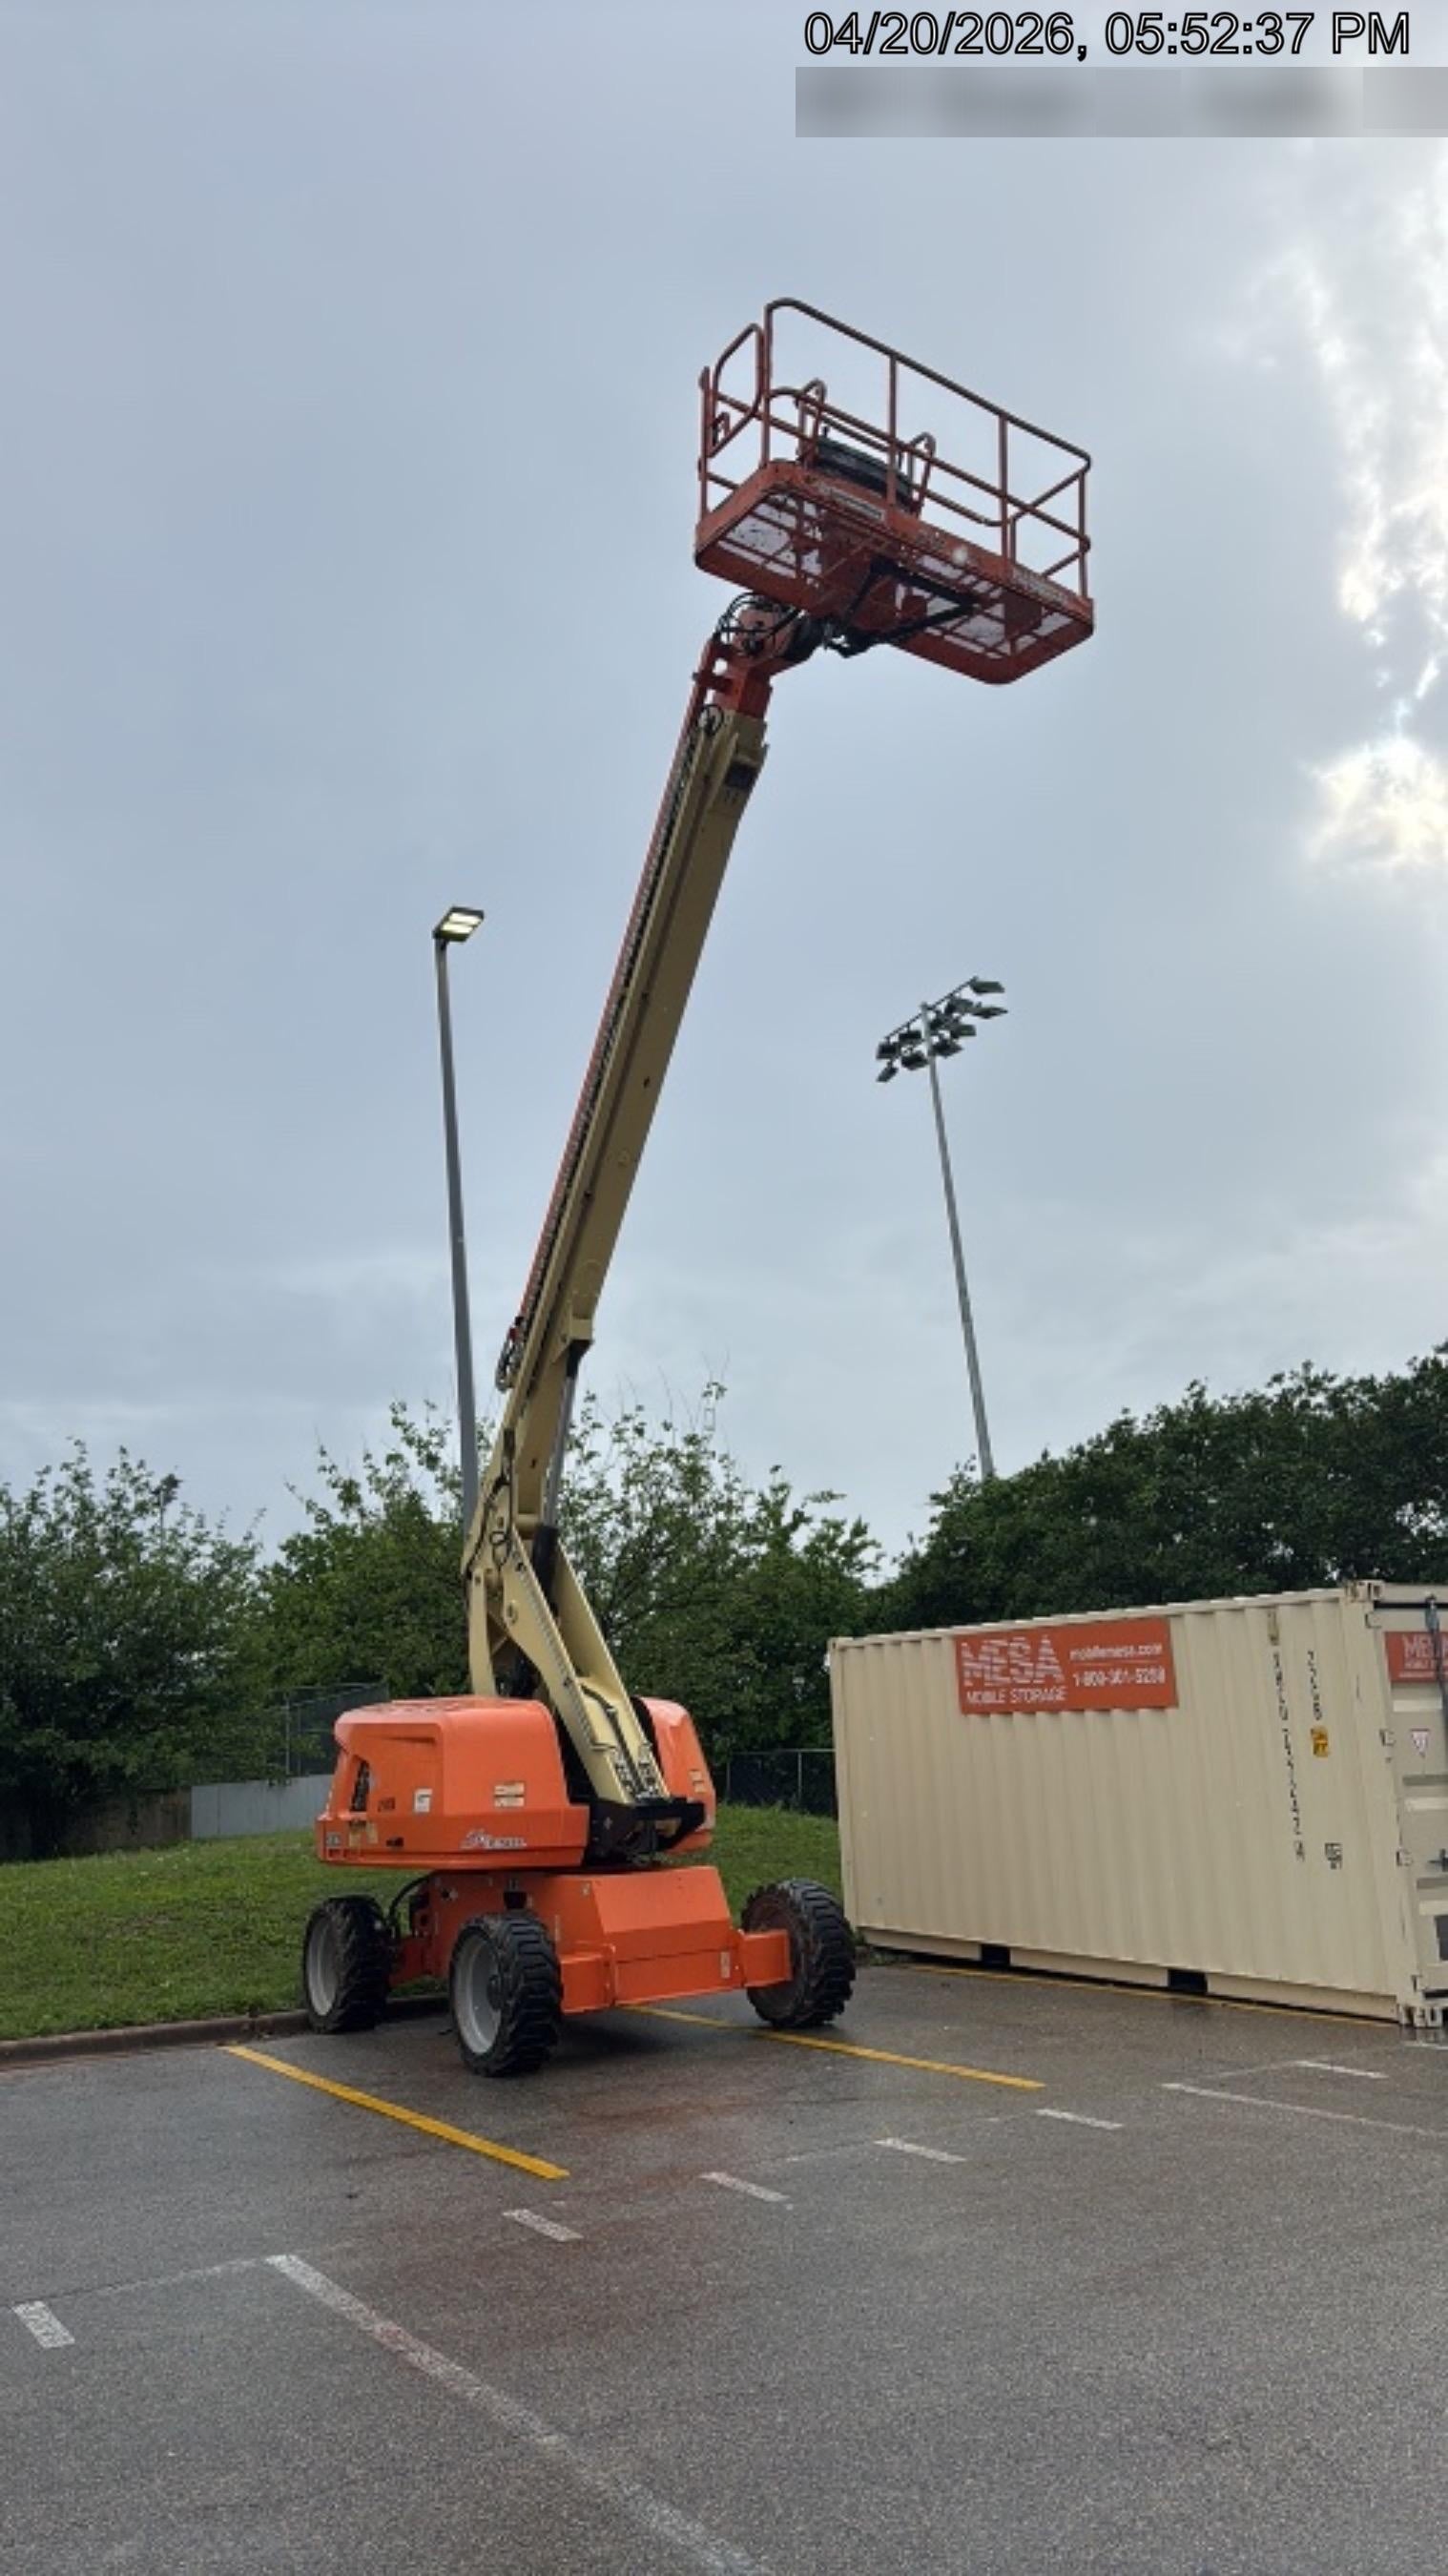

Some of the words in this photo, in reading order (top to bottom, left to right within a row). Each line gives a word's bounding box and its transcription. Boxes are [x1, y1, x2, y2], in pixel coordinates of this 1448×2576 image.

[961, 1635, 1065, 1686] MESA
[966, 1690, 1006, 1705] MOBILE
[1010, 1687, 1067, 1703] STORAGE
